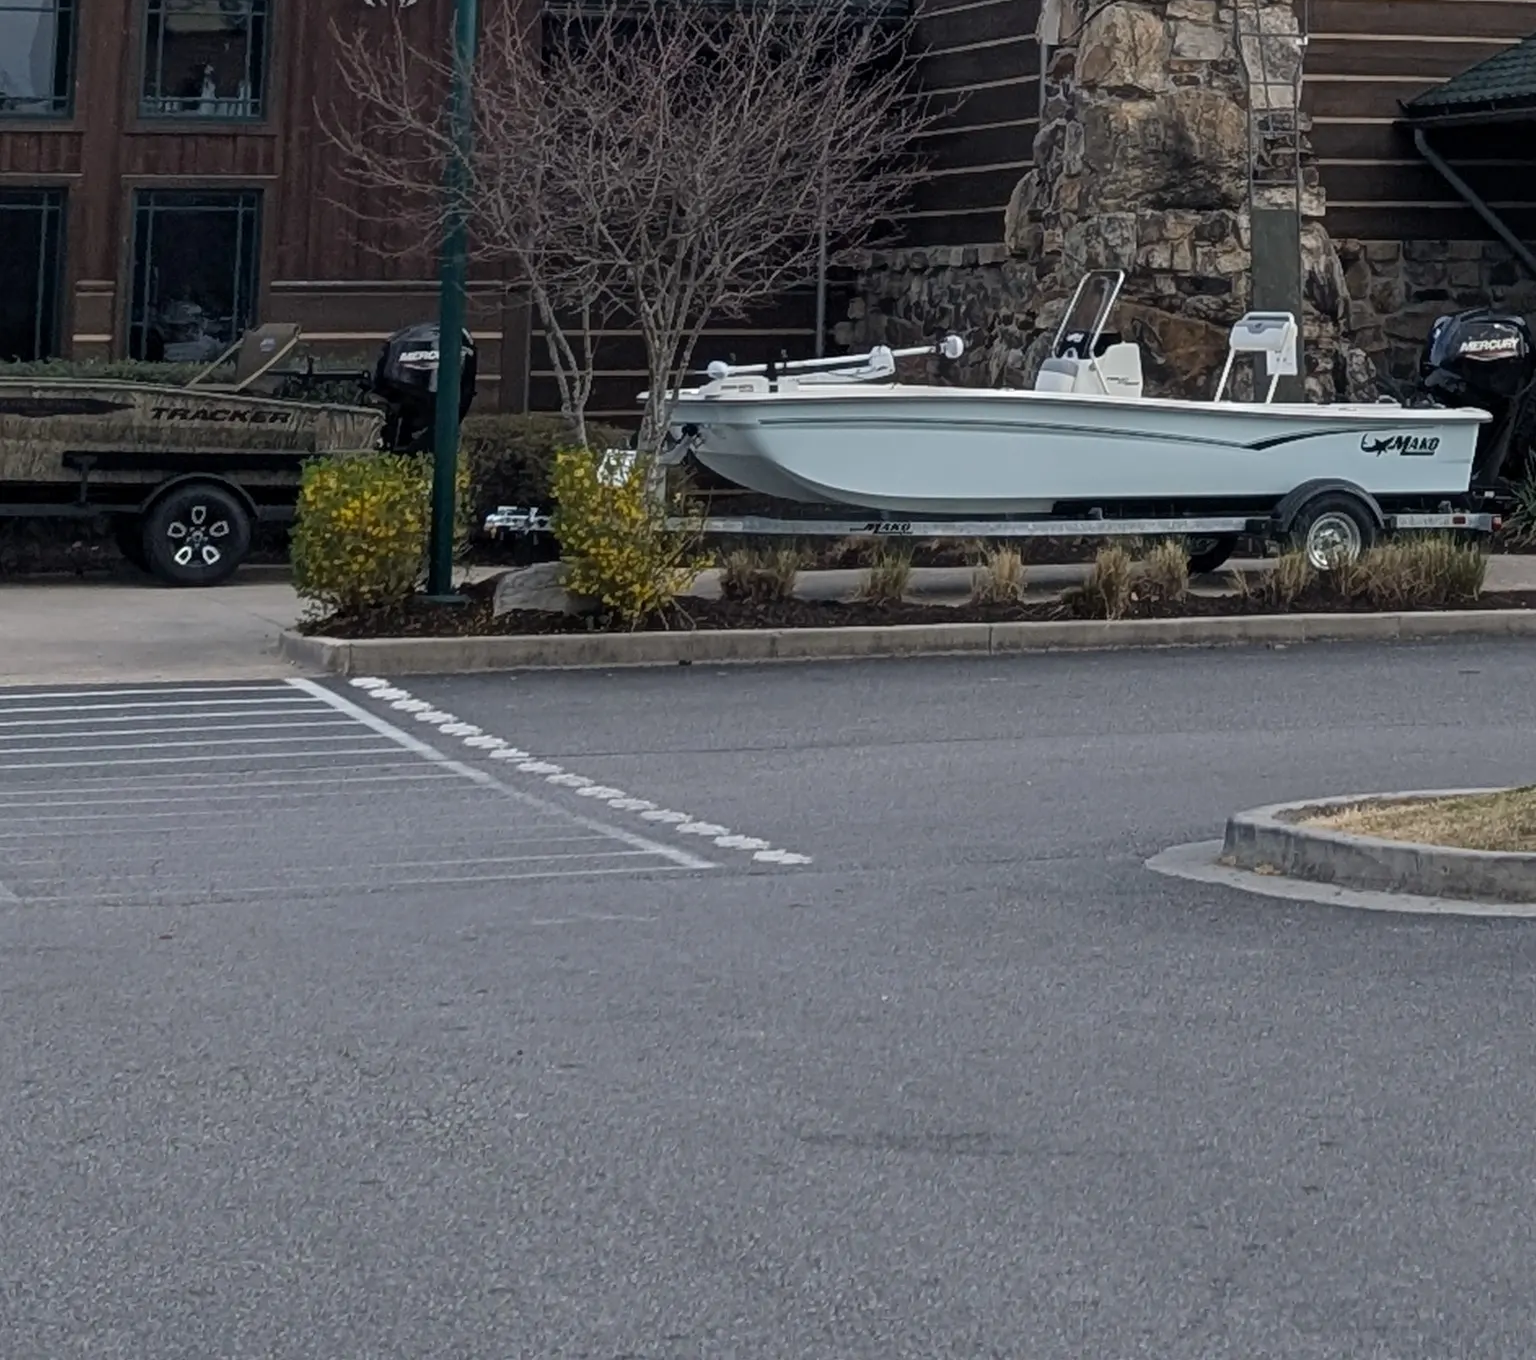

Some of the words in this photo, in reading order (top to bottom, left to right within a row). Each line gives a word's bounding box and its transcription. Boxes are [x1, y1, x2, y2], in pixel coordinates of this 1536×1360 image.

[1459, 337, 1519, 352] MERCURY
[152, 407, 293, 423] TRACKER
[1387, 435, 1440, 455] MAKO
